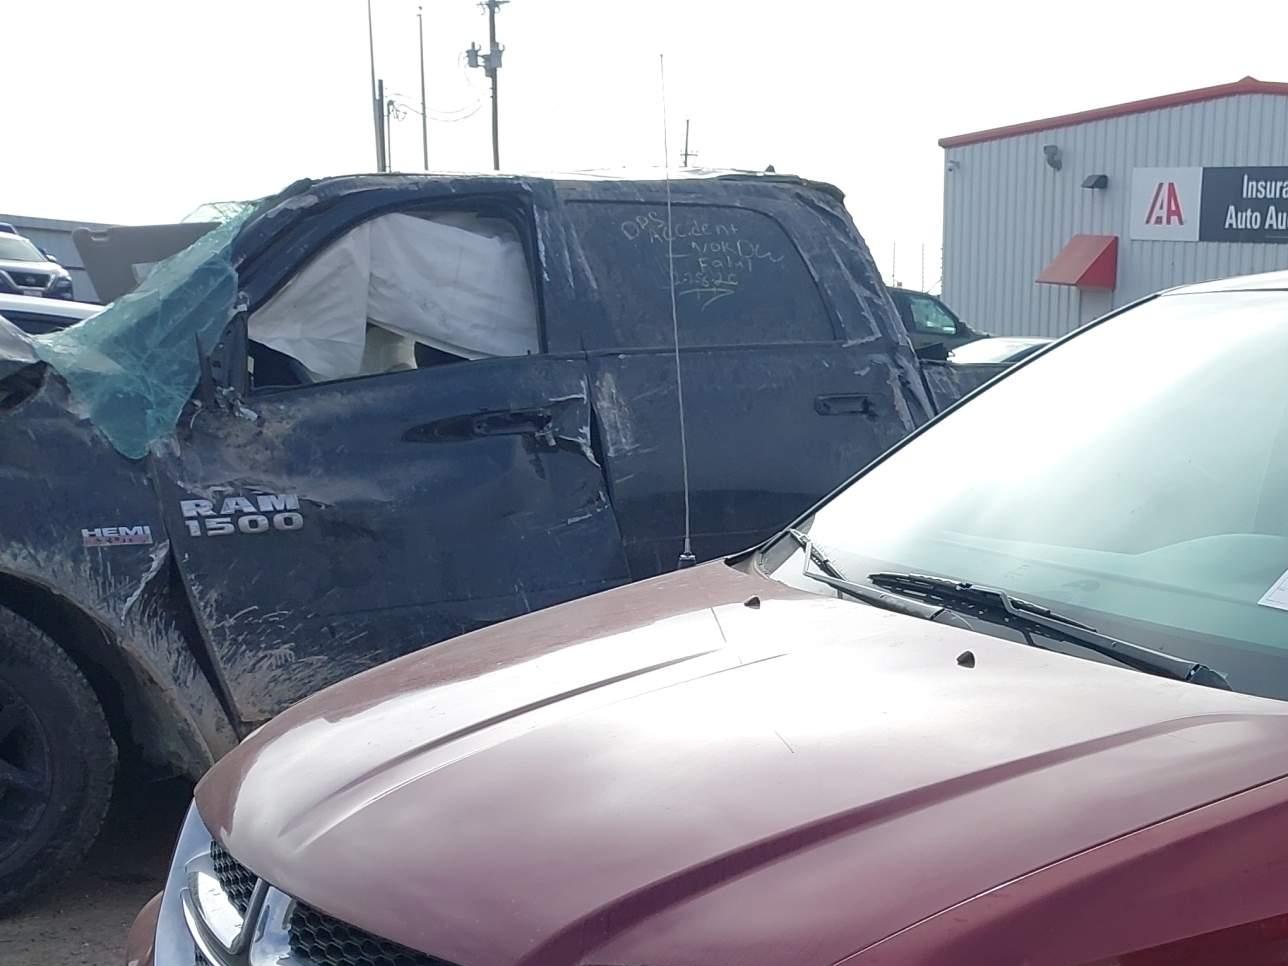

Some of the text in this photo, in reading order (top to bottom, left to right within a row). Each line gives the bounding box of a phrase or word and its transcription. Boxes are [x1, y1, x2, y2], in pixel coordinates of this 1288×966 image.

[1224, 205, 1261, 230] Auto
[180, 494, 300, 518] RAM
[81, 525, 152, 538] HEMI
[184, 511, 304, 537] 1500
